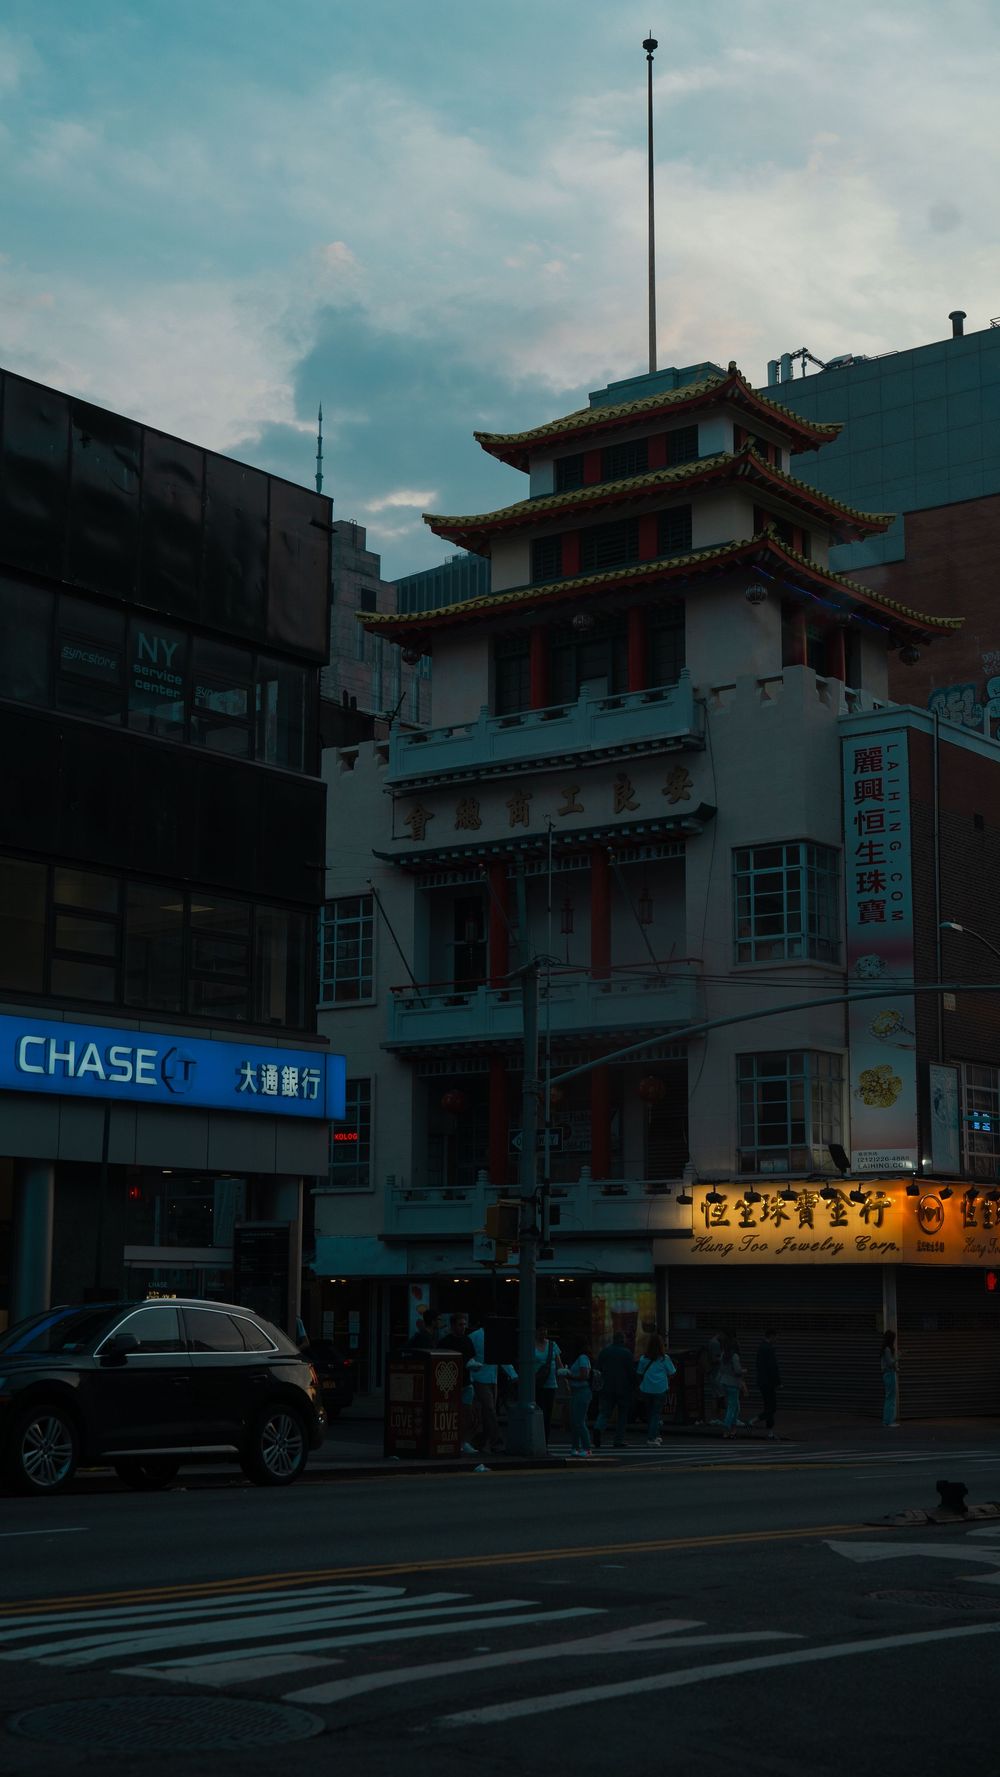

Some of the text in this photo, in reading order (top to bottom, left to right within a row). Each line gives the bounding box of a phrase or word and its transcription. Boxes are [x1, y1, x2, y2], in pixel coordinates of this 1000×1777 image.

[137, 631, 181, 668] NY
[133, 663, 183, 685] service
[134, 679, 182, 699] center
[18, 1034, 159, 1086] CHASE
[238, 1060, 321, 1101] 大通銀行
[691, 1235, 735, 1257] Hung
[738, 1234, 769, 1252] Too
[775, 1236, 845, 1256] Jewelry
[854, 1235, 900, 1254] Corp.
[390, 1414, 413, 1429] LOVE
[433, 1412, 459, 1431] LOVE
